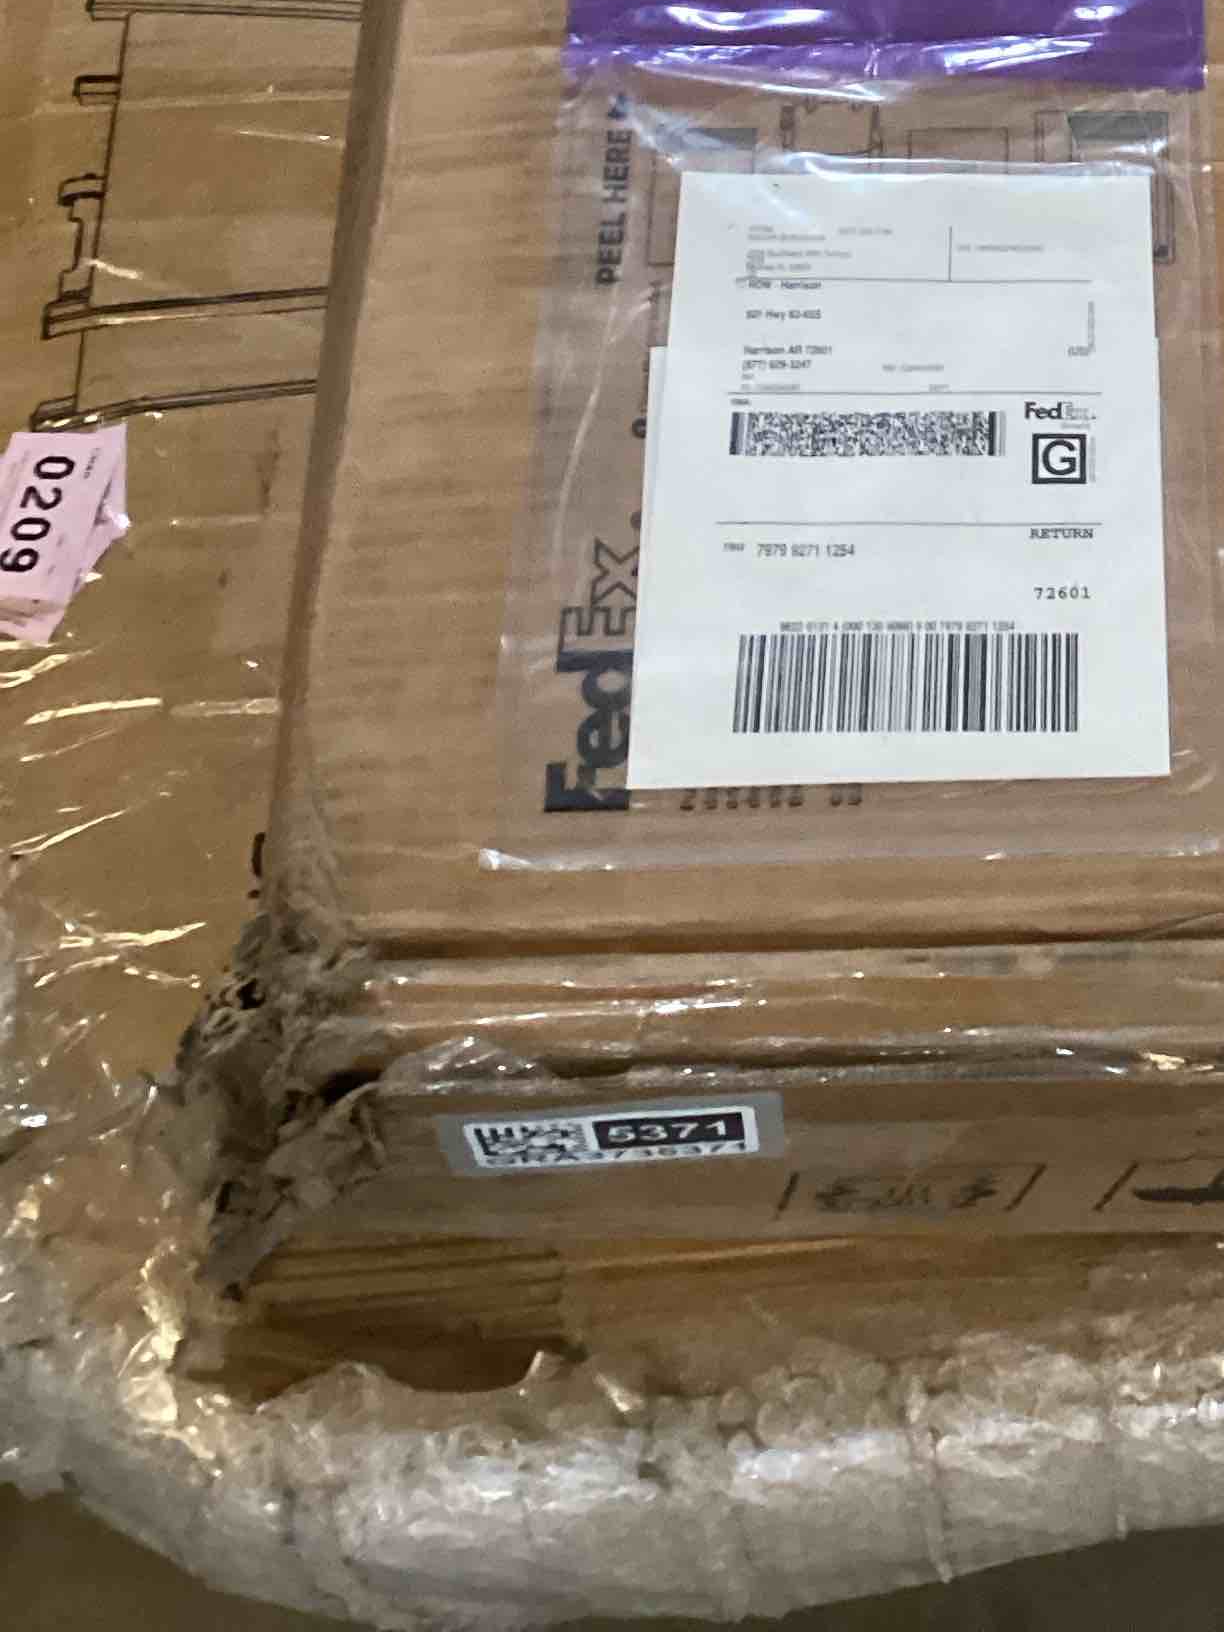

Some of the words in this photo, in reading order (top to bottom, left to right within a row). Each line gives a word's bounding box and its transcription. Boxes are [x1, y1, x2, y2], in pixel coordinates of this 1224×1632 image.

[602, 129, 633, 202] HERE
[596, 211, 626, 286] PEEL
[1042, 439, 1076, 475] G
[0, 455, 75, 573] 0209
[1029, 528, 1094, 539] RETURN
[826, 543, 855, 557] 1254
[1033, 586, 1091, 600] 72601
[607, 1119, 728, 1143] 5371
